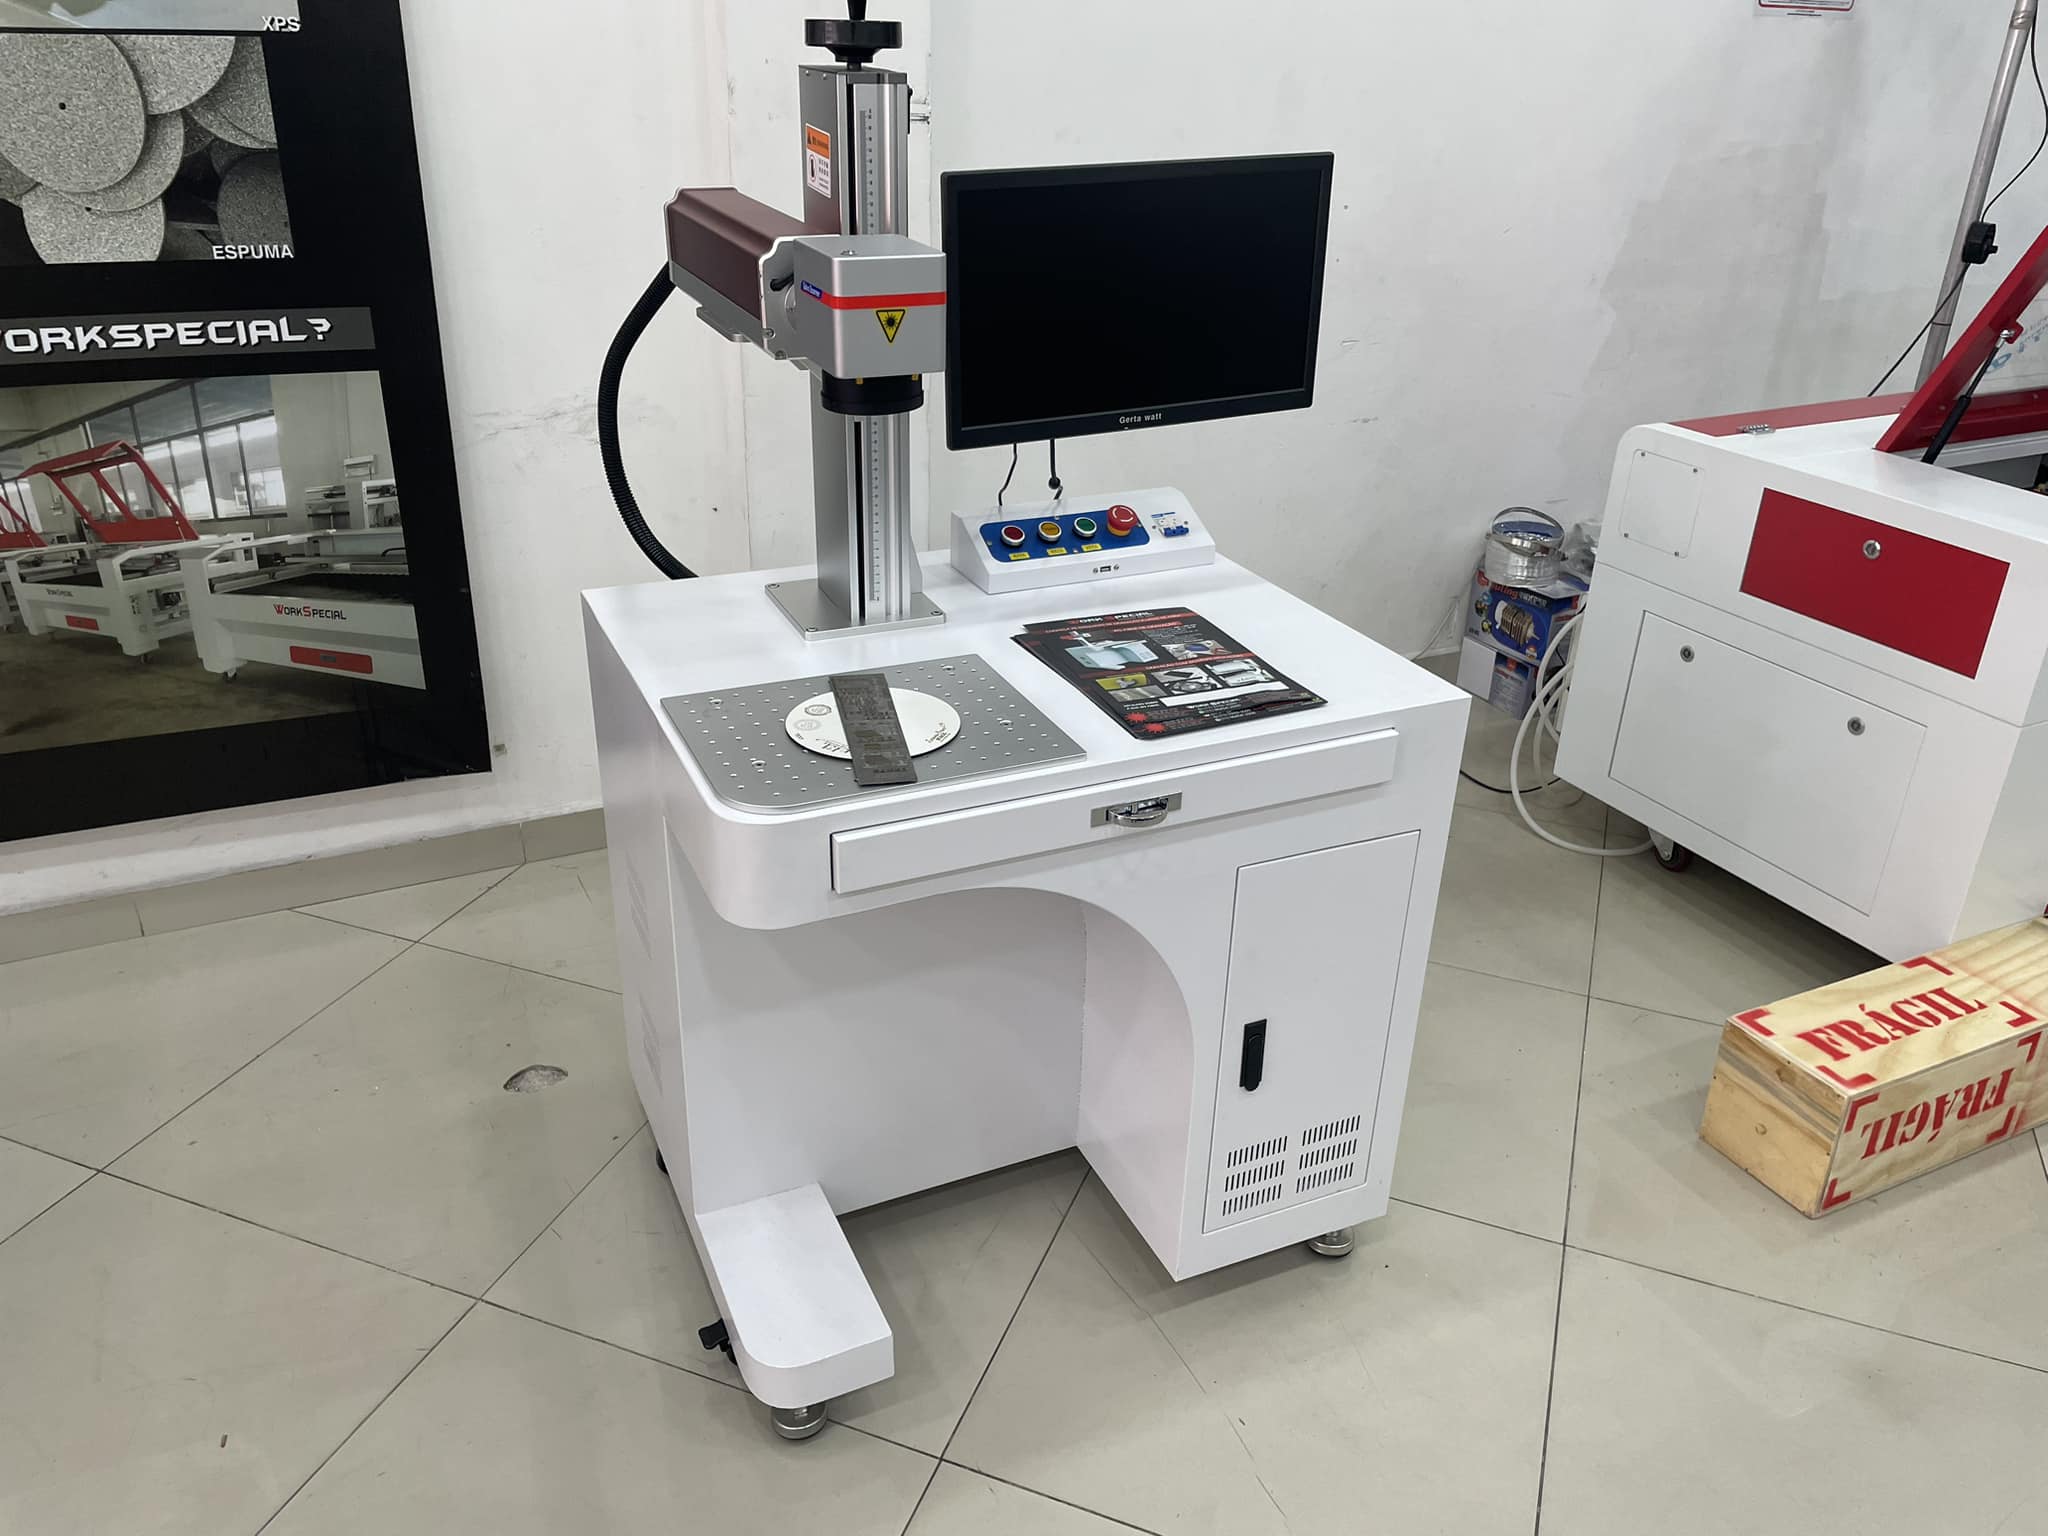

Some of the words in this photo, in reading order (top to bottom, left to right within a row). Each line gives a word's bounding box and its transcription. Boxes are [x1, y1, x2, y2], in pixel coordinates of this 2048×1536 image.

[261, 16, 300, 32] XPS
[212, 244, 294, 260] ESPUMA
[0, 316, 332, 355] ORKSPECIAL?
[1119, 415, 1141, 424] Gerta
[1795, 987, 1988, 1061] FRÁGIL
[1860, 1067, 2016, 1161] FRÁGIL
